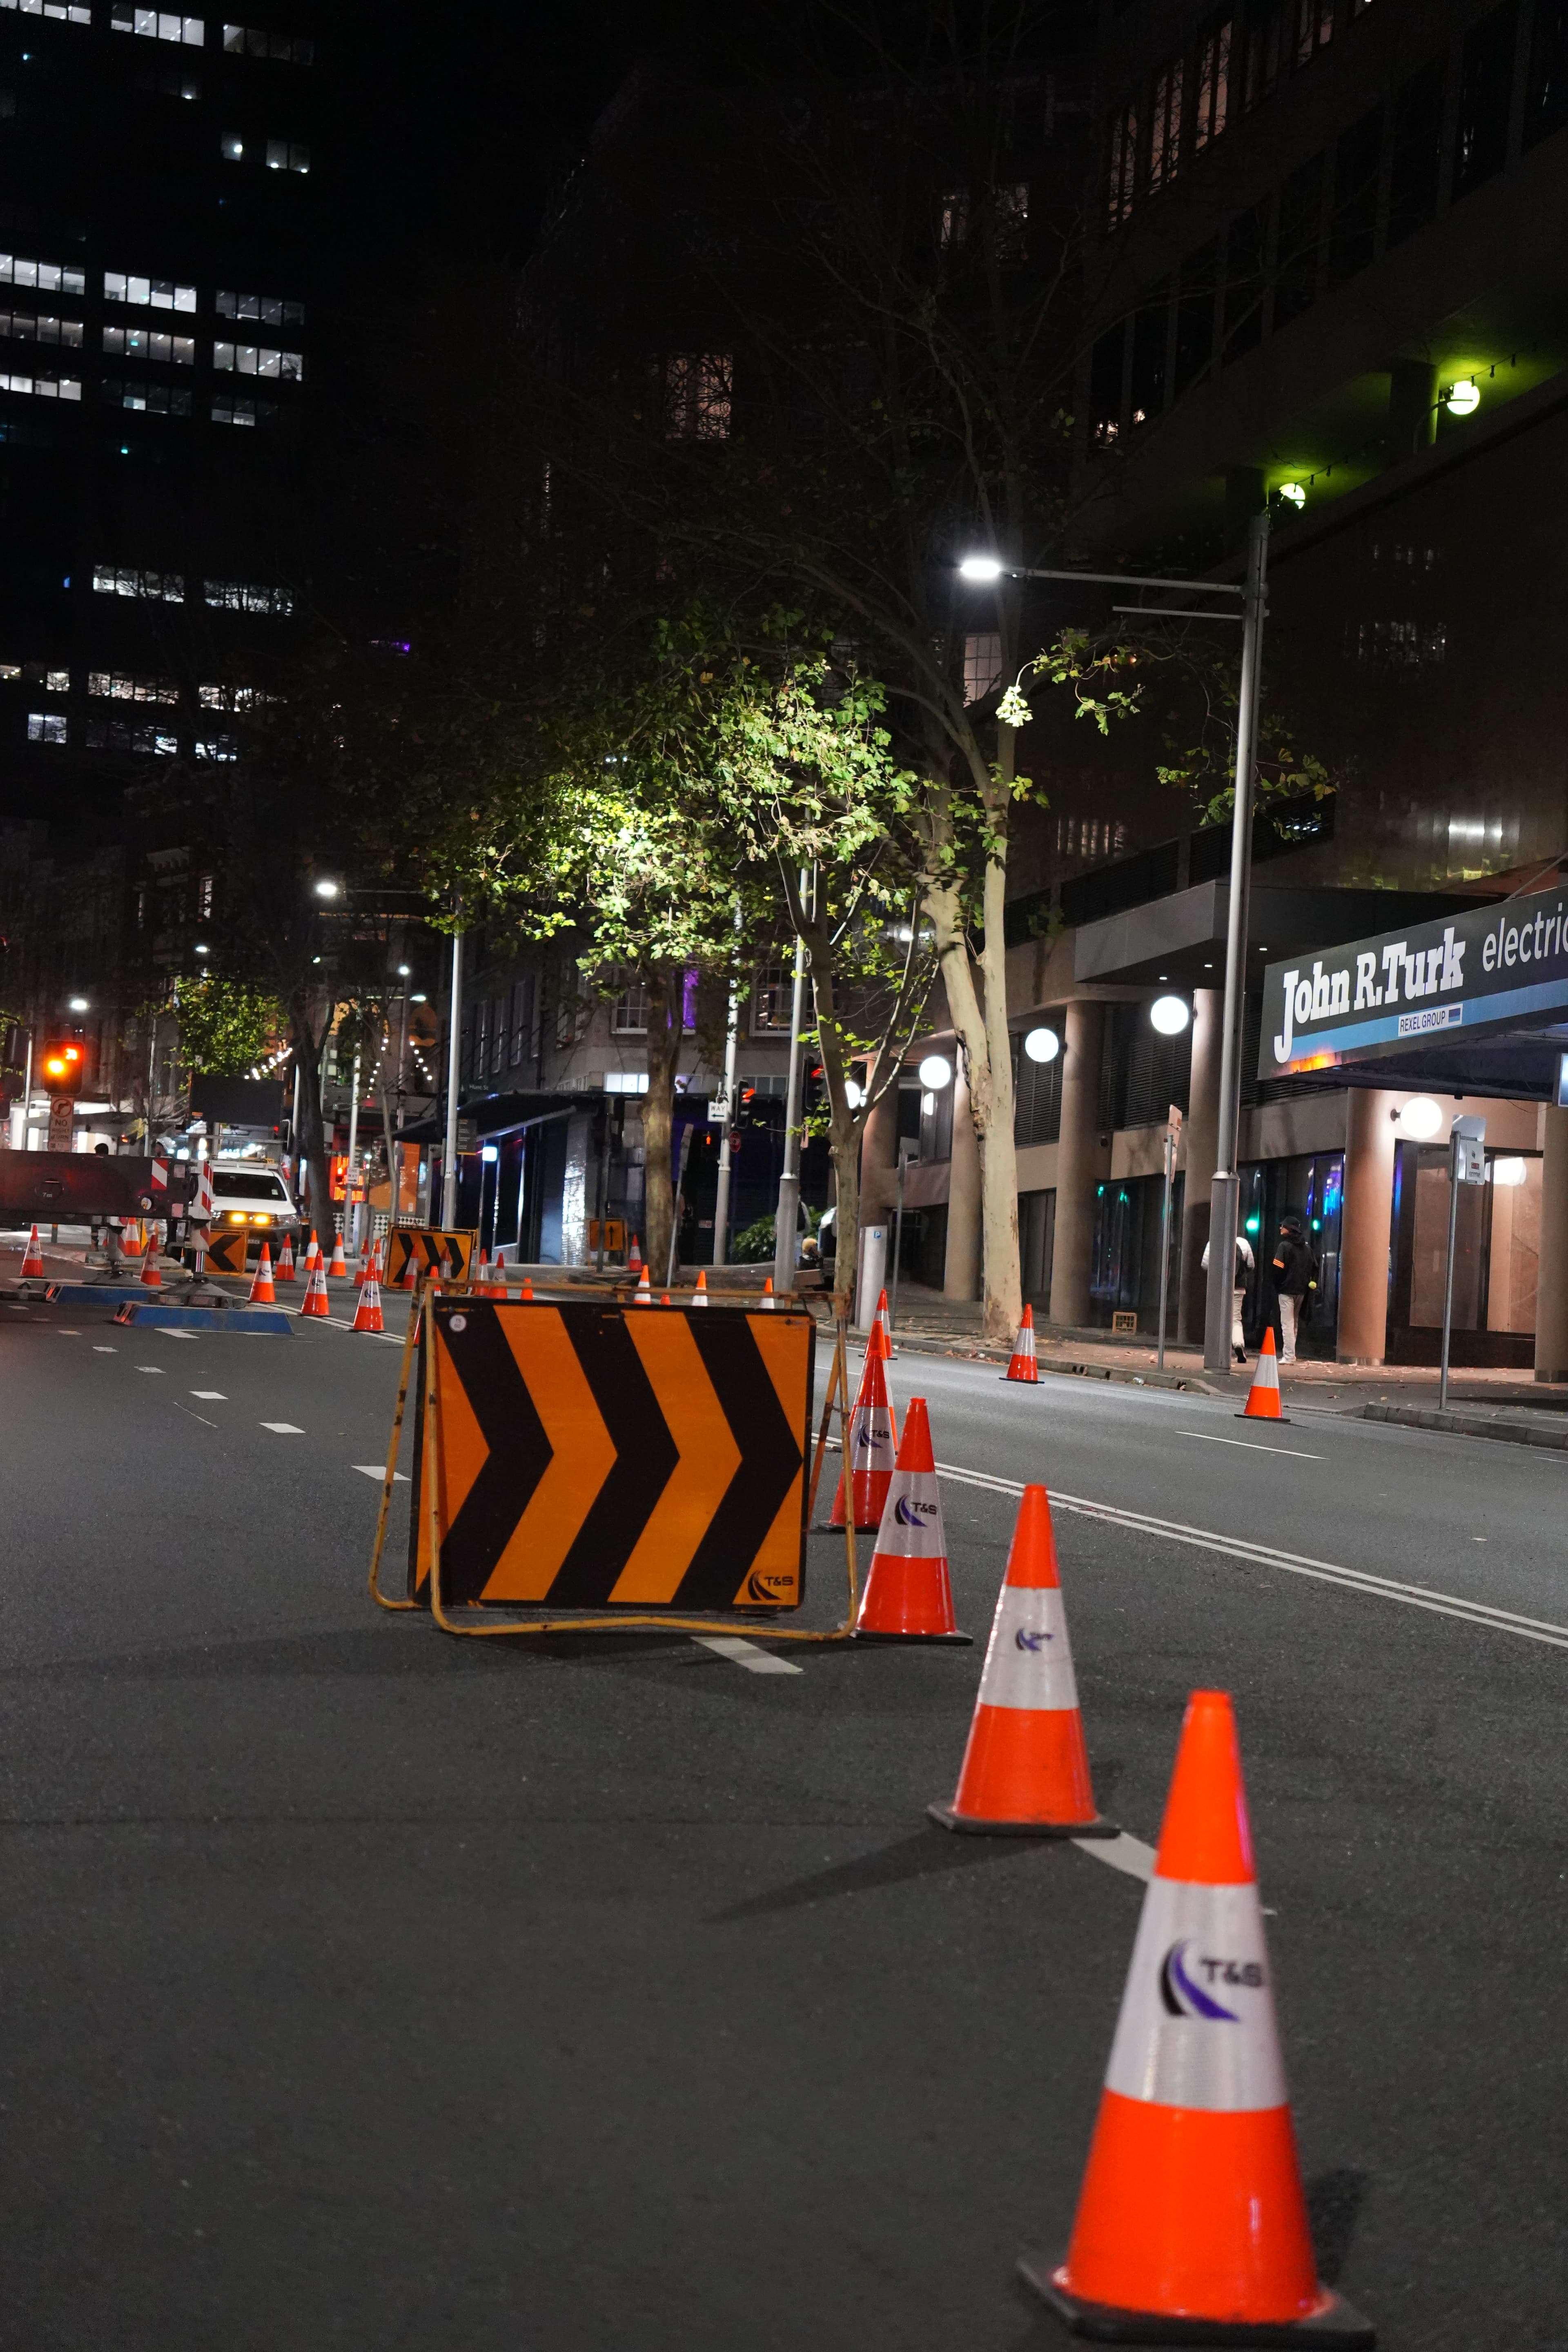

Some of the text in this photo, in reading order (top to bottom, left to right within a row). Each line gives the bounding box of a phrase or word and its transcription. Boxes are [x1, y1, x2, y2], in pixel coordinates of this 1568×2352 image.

[1274, 961, 1350, 1063] John
[1400, 1011, 1446, 1032] REXEL GROUP
[872, 1430, 889, 1439] T&S
[912, 1502, 937, 1515] T&S
[764, 1576, 793, 1586] T&S
[1199, 1958, 1263, 1988] T&S
